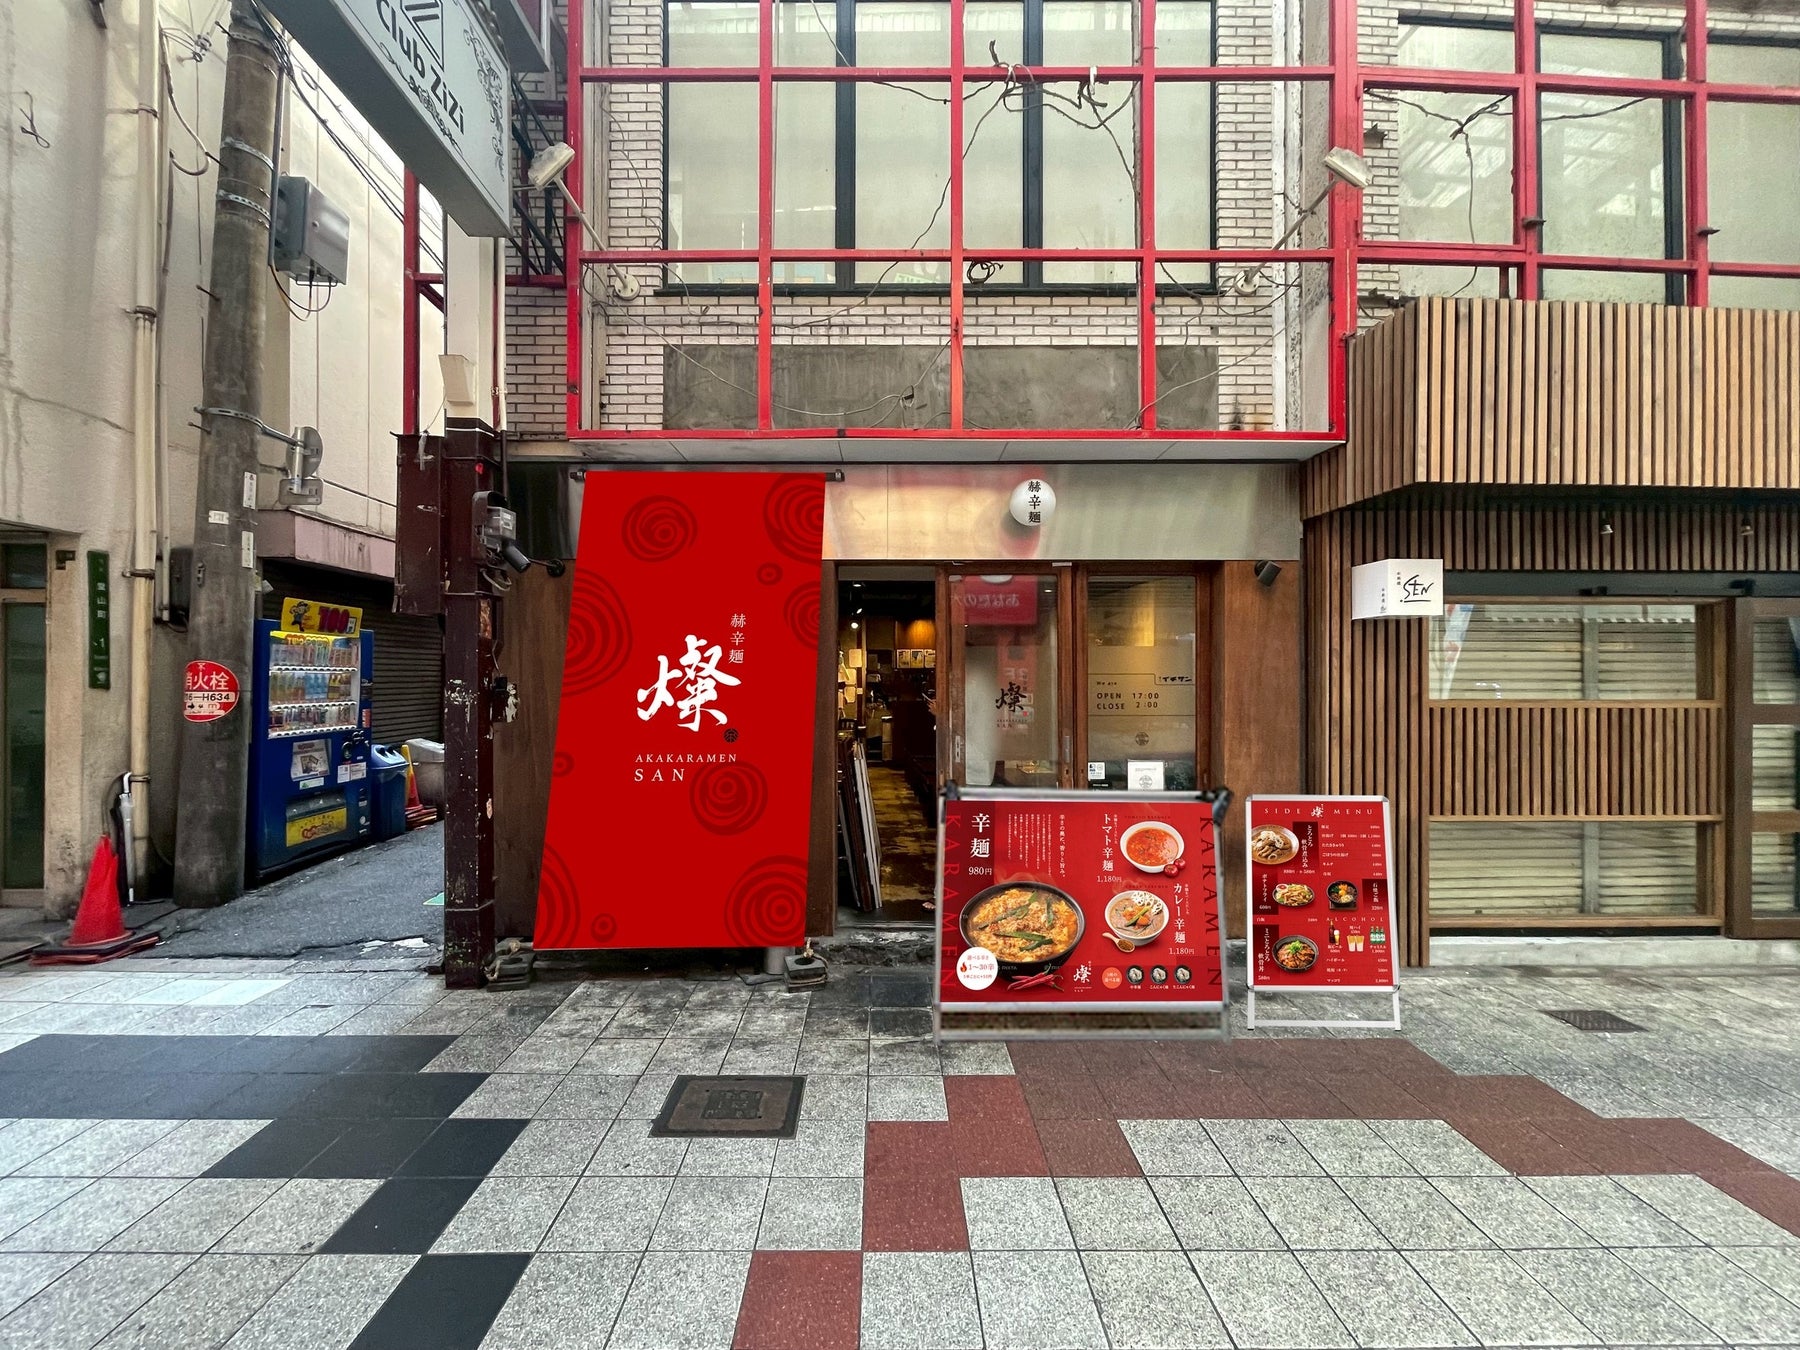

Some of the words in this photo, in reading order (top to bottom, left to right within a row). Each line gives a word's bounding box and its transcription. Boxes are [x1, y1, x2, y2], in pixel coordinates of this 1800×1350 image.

[1028, 480, 1041, 523] 赫辛麺
[728, 613, 747, 664] 赫辛麺
[636, 634, 742, 732] 燦
[634, 768, 685, 782] SAN
[635, 754, 737, 762] AKAKARAMEN
[1264, 807, 1301, 815] SIDE
[969, 813, 991, 858] 辛麺
[1102, 813, 1114, 872] トマト辛麺
[968, 866, 993, 876] 980円
[1173, 883, 1186, 944] カレー辛麺
[1168, 947, 1195, 955] 1,180円
